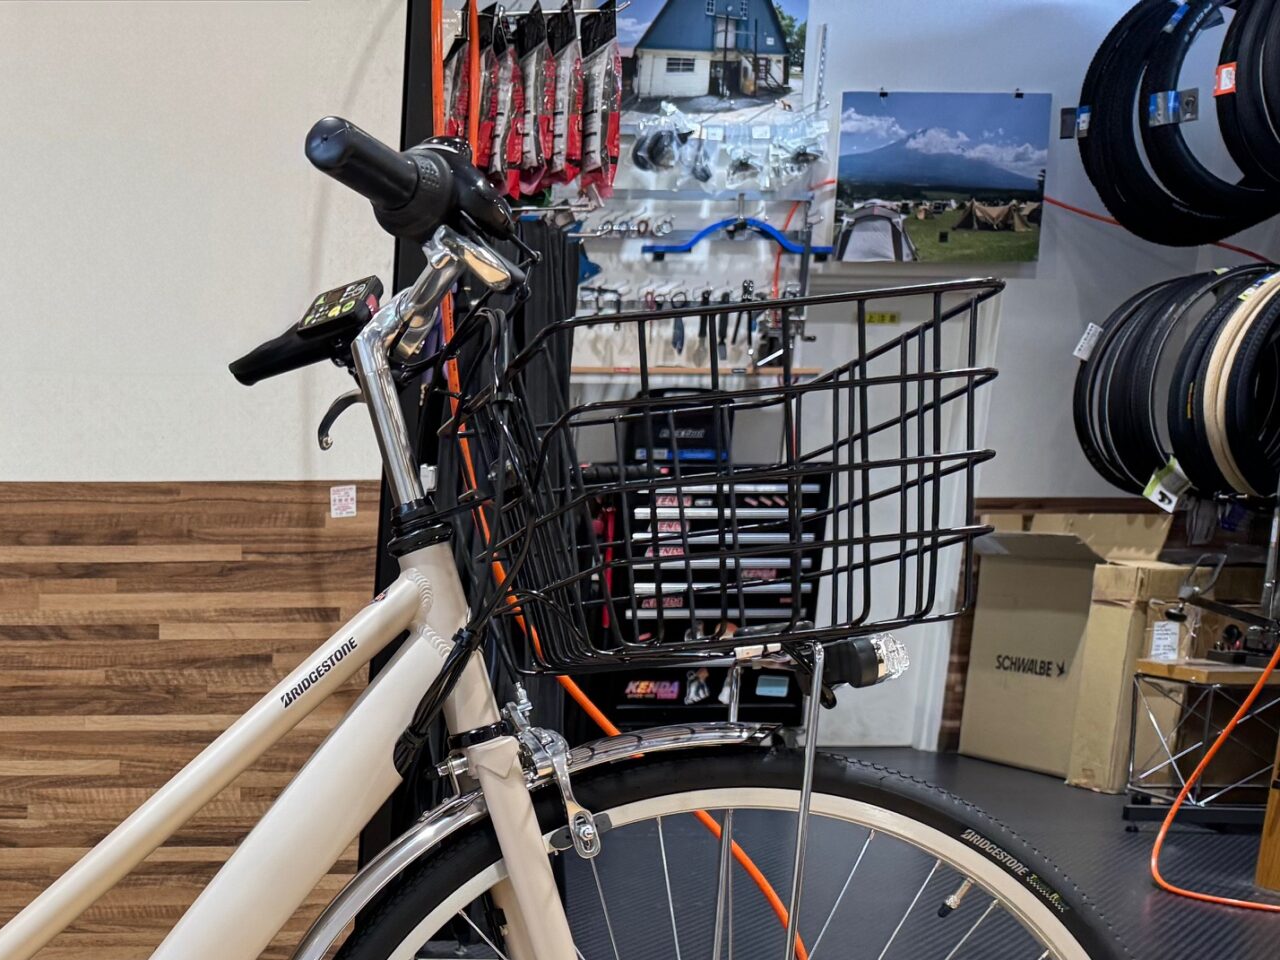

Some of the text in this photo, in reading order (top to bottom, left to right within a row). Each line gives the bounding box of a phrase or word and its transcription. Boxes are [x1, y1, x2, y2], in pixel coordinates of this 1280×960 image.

[280, 636, 358, 708] BRIDGESTONE
[995, 654, 1053, 677] SCHWALBE
[625, 680, 680, 694] KENDA
[960, 829, 1029, 876] BRIDGESTONE
